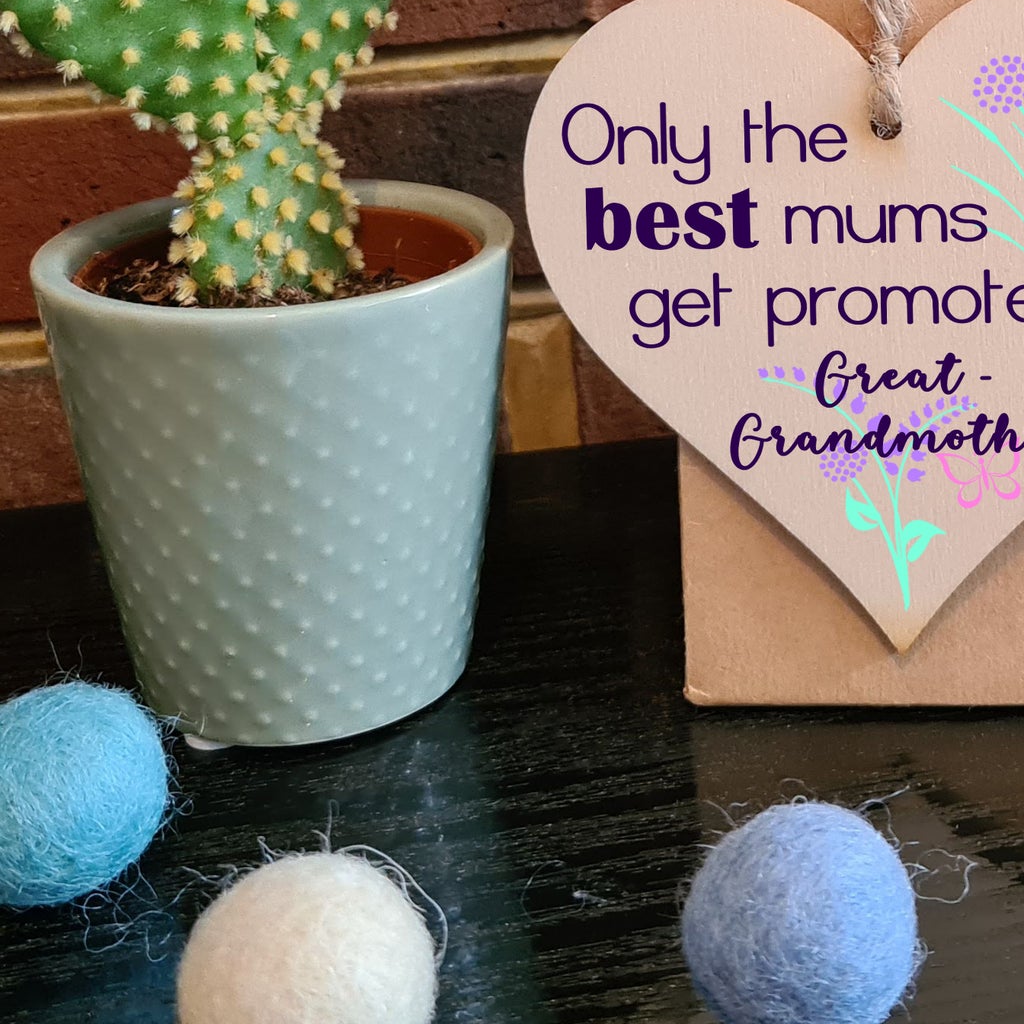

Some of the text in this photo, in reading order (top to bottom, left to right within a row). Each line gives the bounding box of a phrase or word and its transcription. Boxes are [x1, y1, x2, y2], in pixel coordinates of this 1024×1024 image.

[561, 100, 848, 185] Only the
[585, 186, 988, 251] best mums
[628, 272, 733, 349] get
[814, 350, 966, 409] Great
